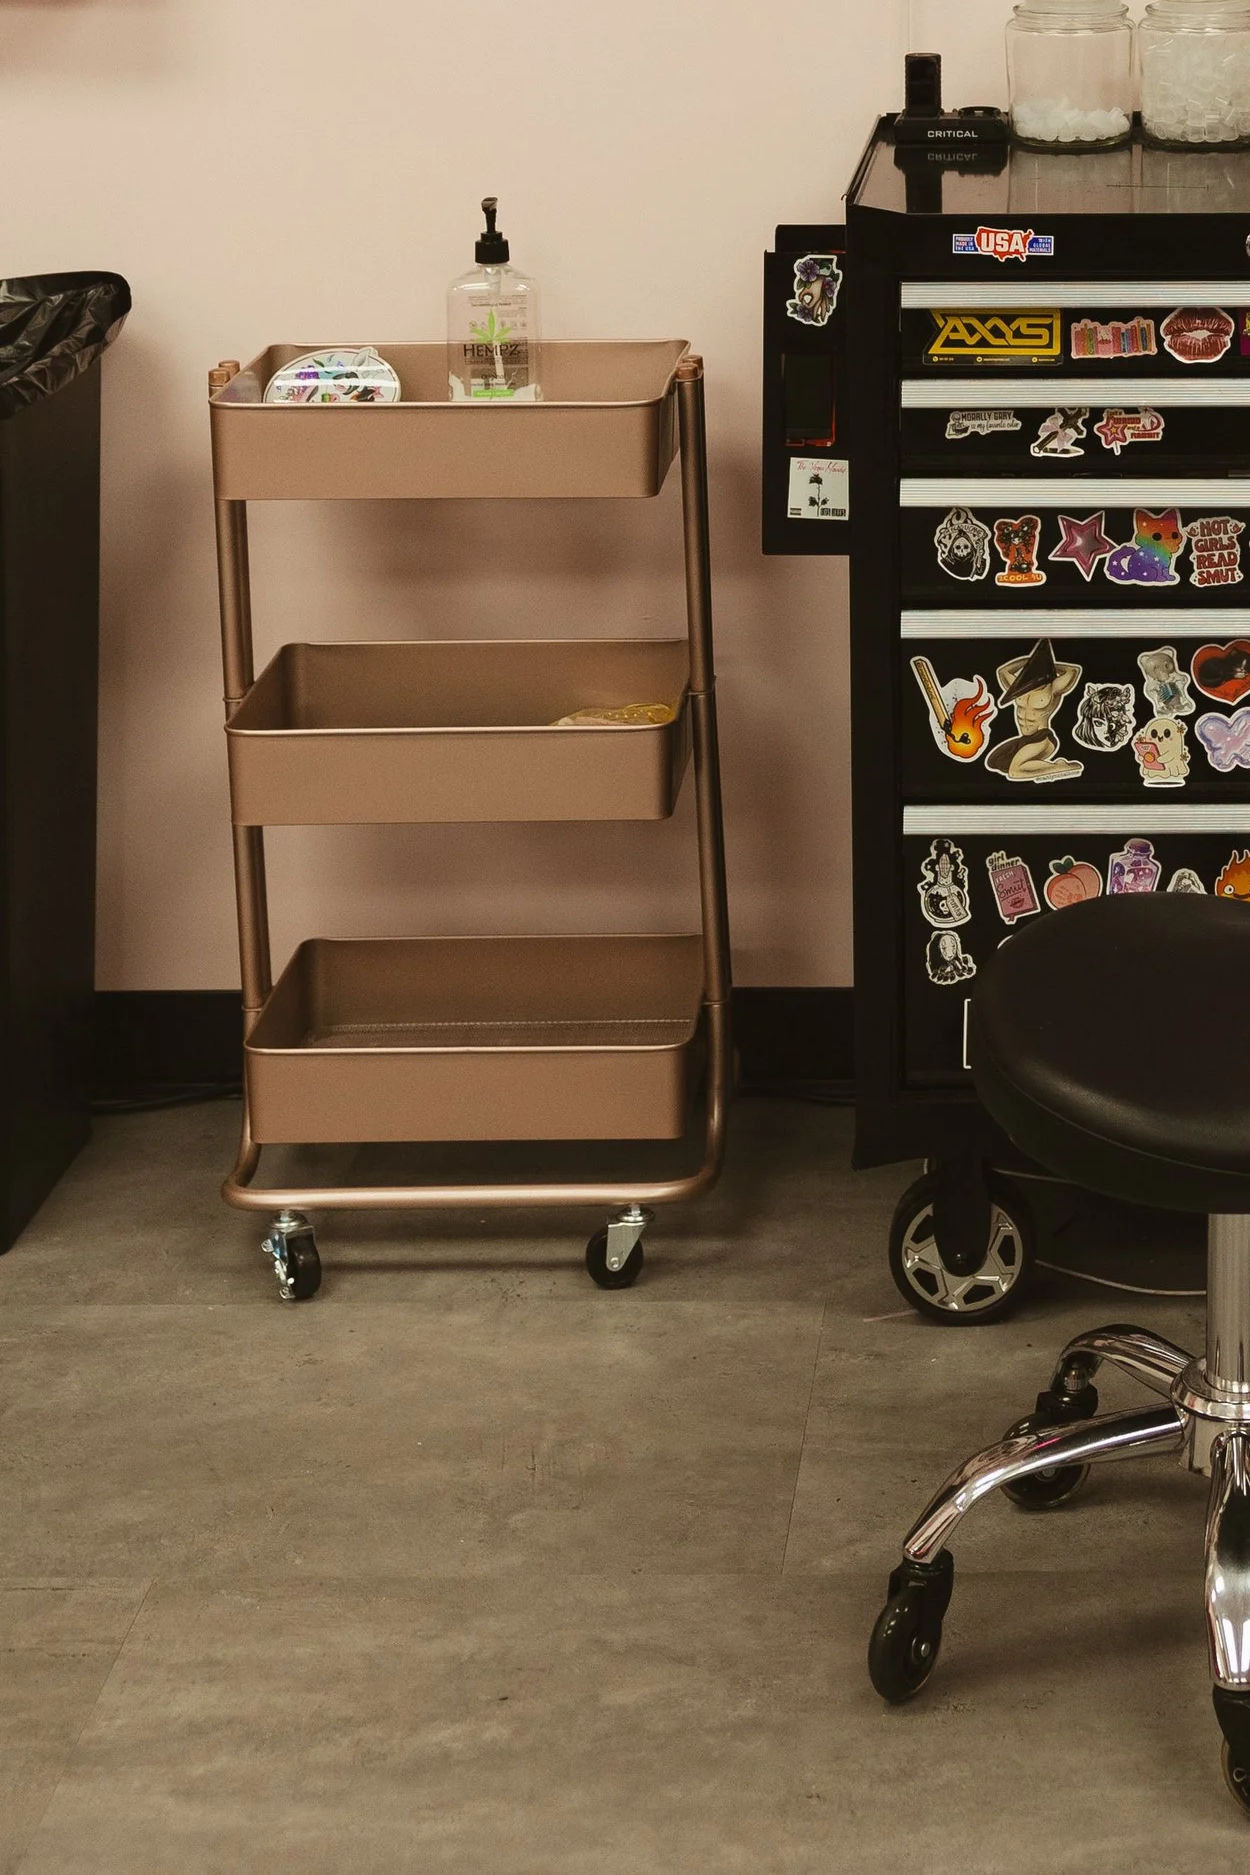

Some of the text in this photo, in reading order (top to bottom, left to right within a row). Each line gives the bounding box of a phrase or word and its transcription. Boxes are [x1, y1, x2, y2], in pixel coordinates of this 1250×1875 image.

[927, 129, 979, 138] CRITICAL
[981, 232, 1025, 253] USA
[463, 343, 521, 358] HEMPZ
[1200, 519, 1230, 538] HOT
[1194, 535, 1237, 553] GIRLS
[1196, 552, 1238, 570] READ
[1197, 568, 1237, 585] SMUT
[988, 854, 1006, 866] girl
[991, 857, 1020, 872] dinner
